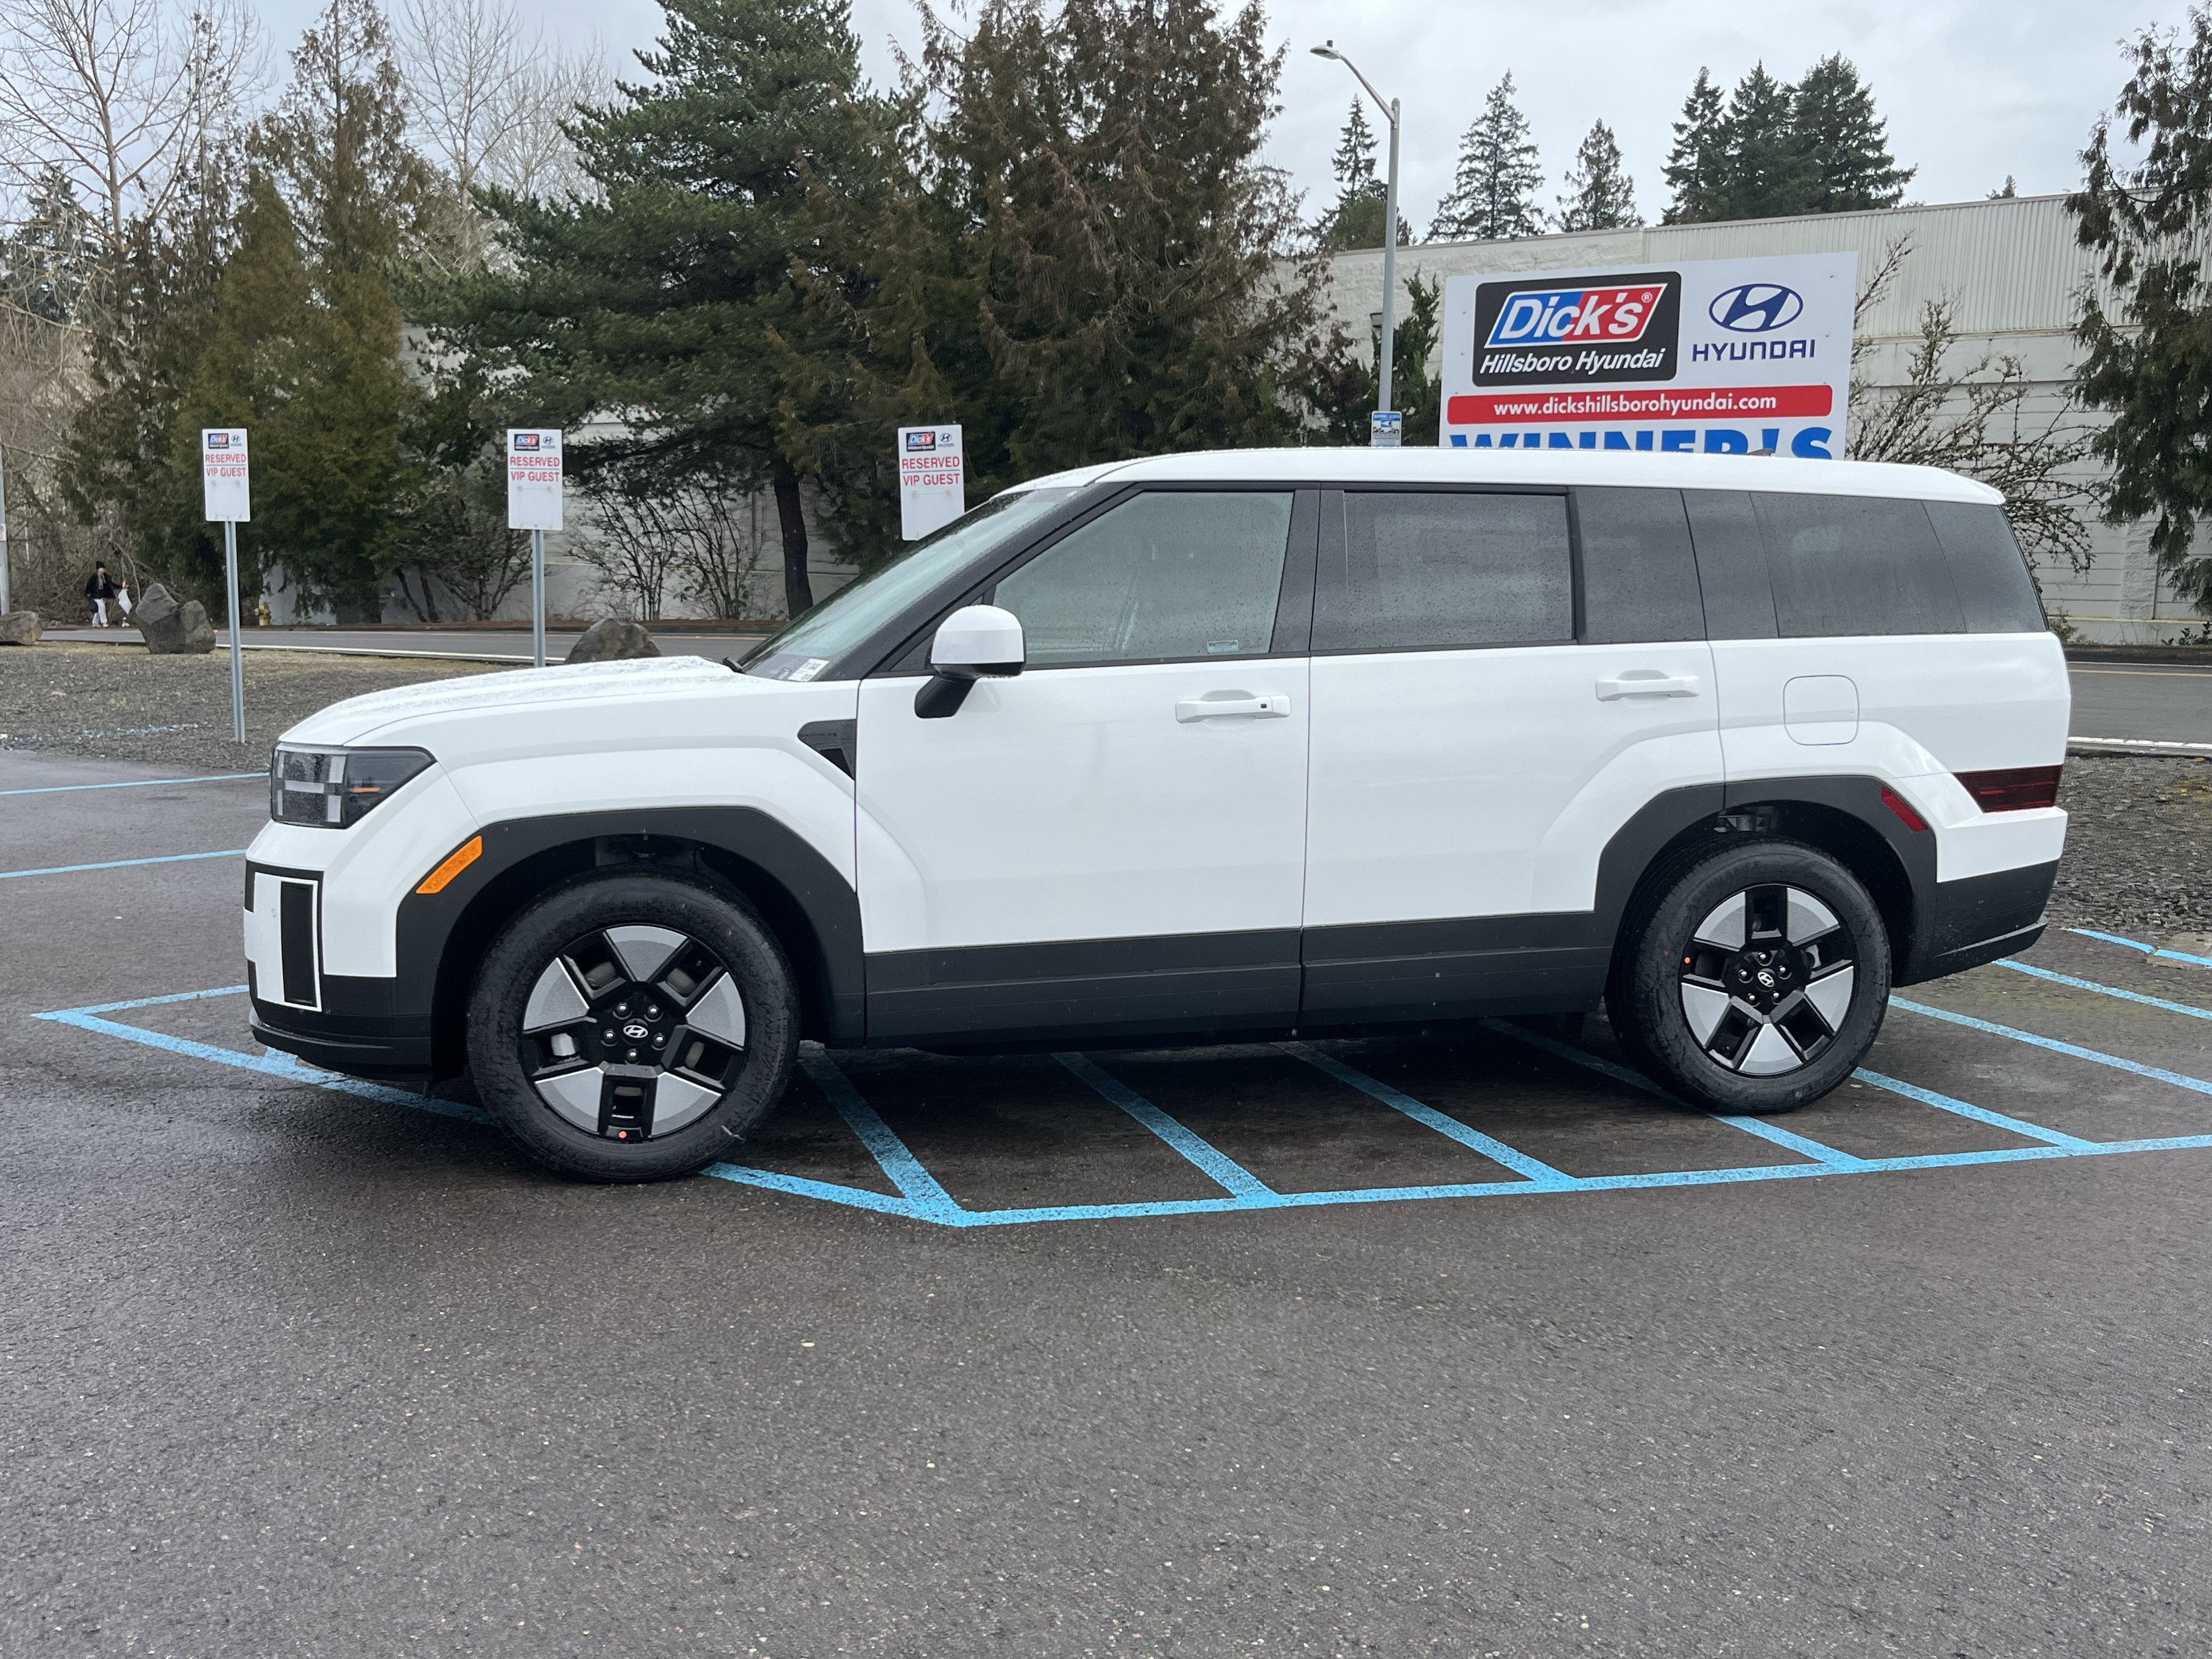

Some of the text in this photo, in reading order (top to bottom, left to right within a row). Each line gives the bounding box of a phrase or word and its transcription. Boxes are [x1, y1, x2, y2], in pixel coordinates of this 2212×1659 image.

[1692, 339, 1815, 362] HYUNDAI
[1480, 348, 1666, 375] Hillsboro Hyundai
[1494, 392, 1776, 416] www.dickshillsborohyundai.com
[205, 454, 246, 463] RESERVED
[510, 456, 560, 467] RESERVED
[902, 456, 960, 470] RESERVED
[206, 467, 246, 477] VIP GUEST
[511, 472, 560, 482] VIP GUEST
[902, 473, 960, 486] VIP GUEST
